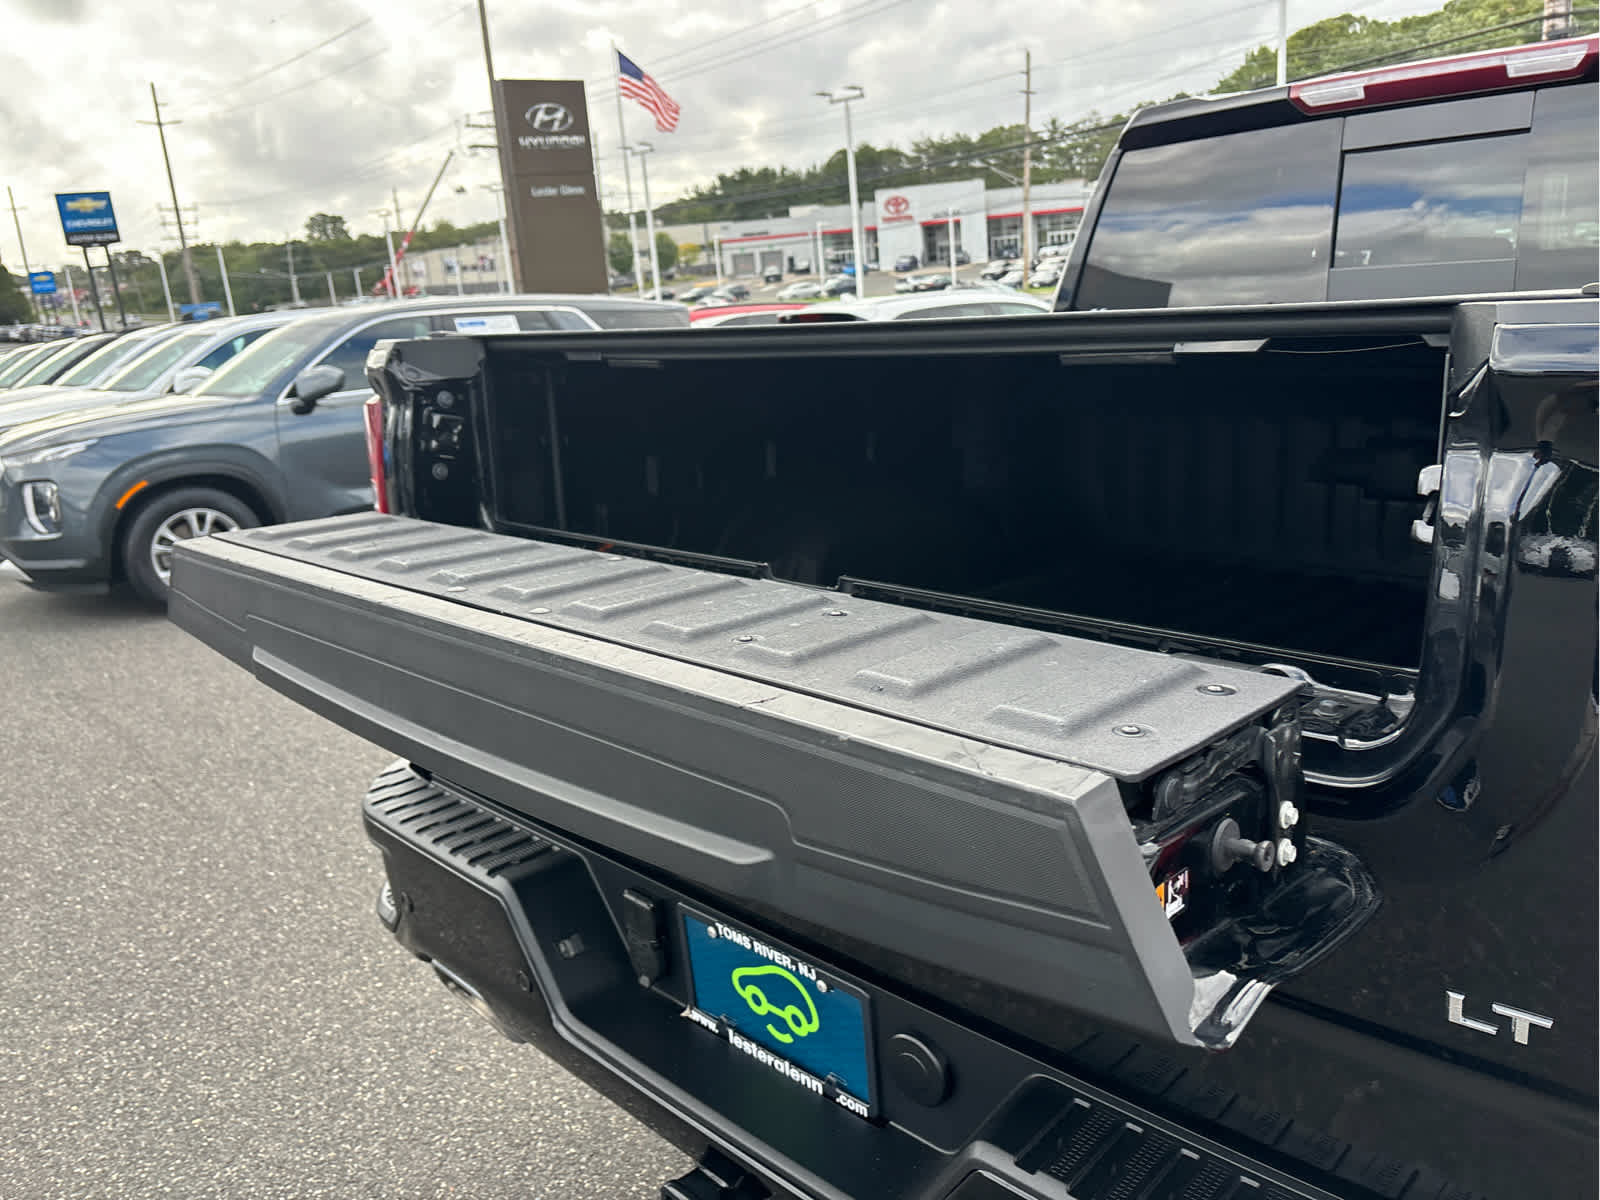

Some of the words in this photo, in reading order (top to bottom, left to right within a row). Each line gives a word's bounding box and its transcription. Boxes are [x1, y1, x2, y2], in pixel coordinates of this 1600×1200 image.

[715, 922, 752, 950] TOMS
[753, 940, 796, 972] RIVER,
[798, 961, 817, 982] NJ
[1446, 990, 1554, 1046] LT
